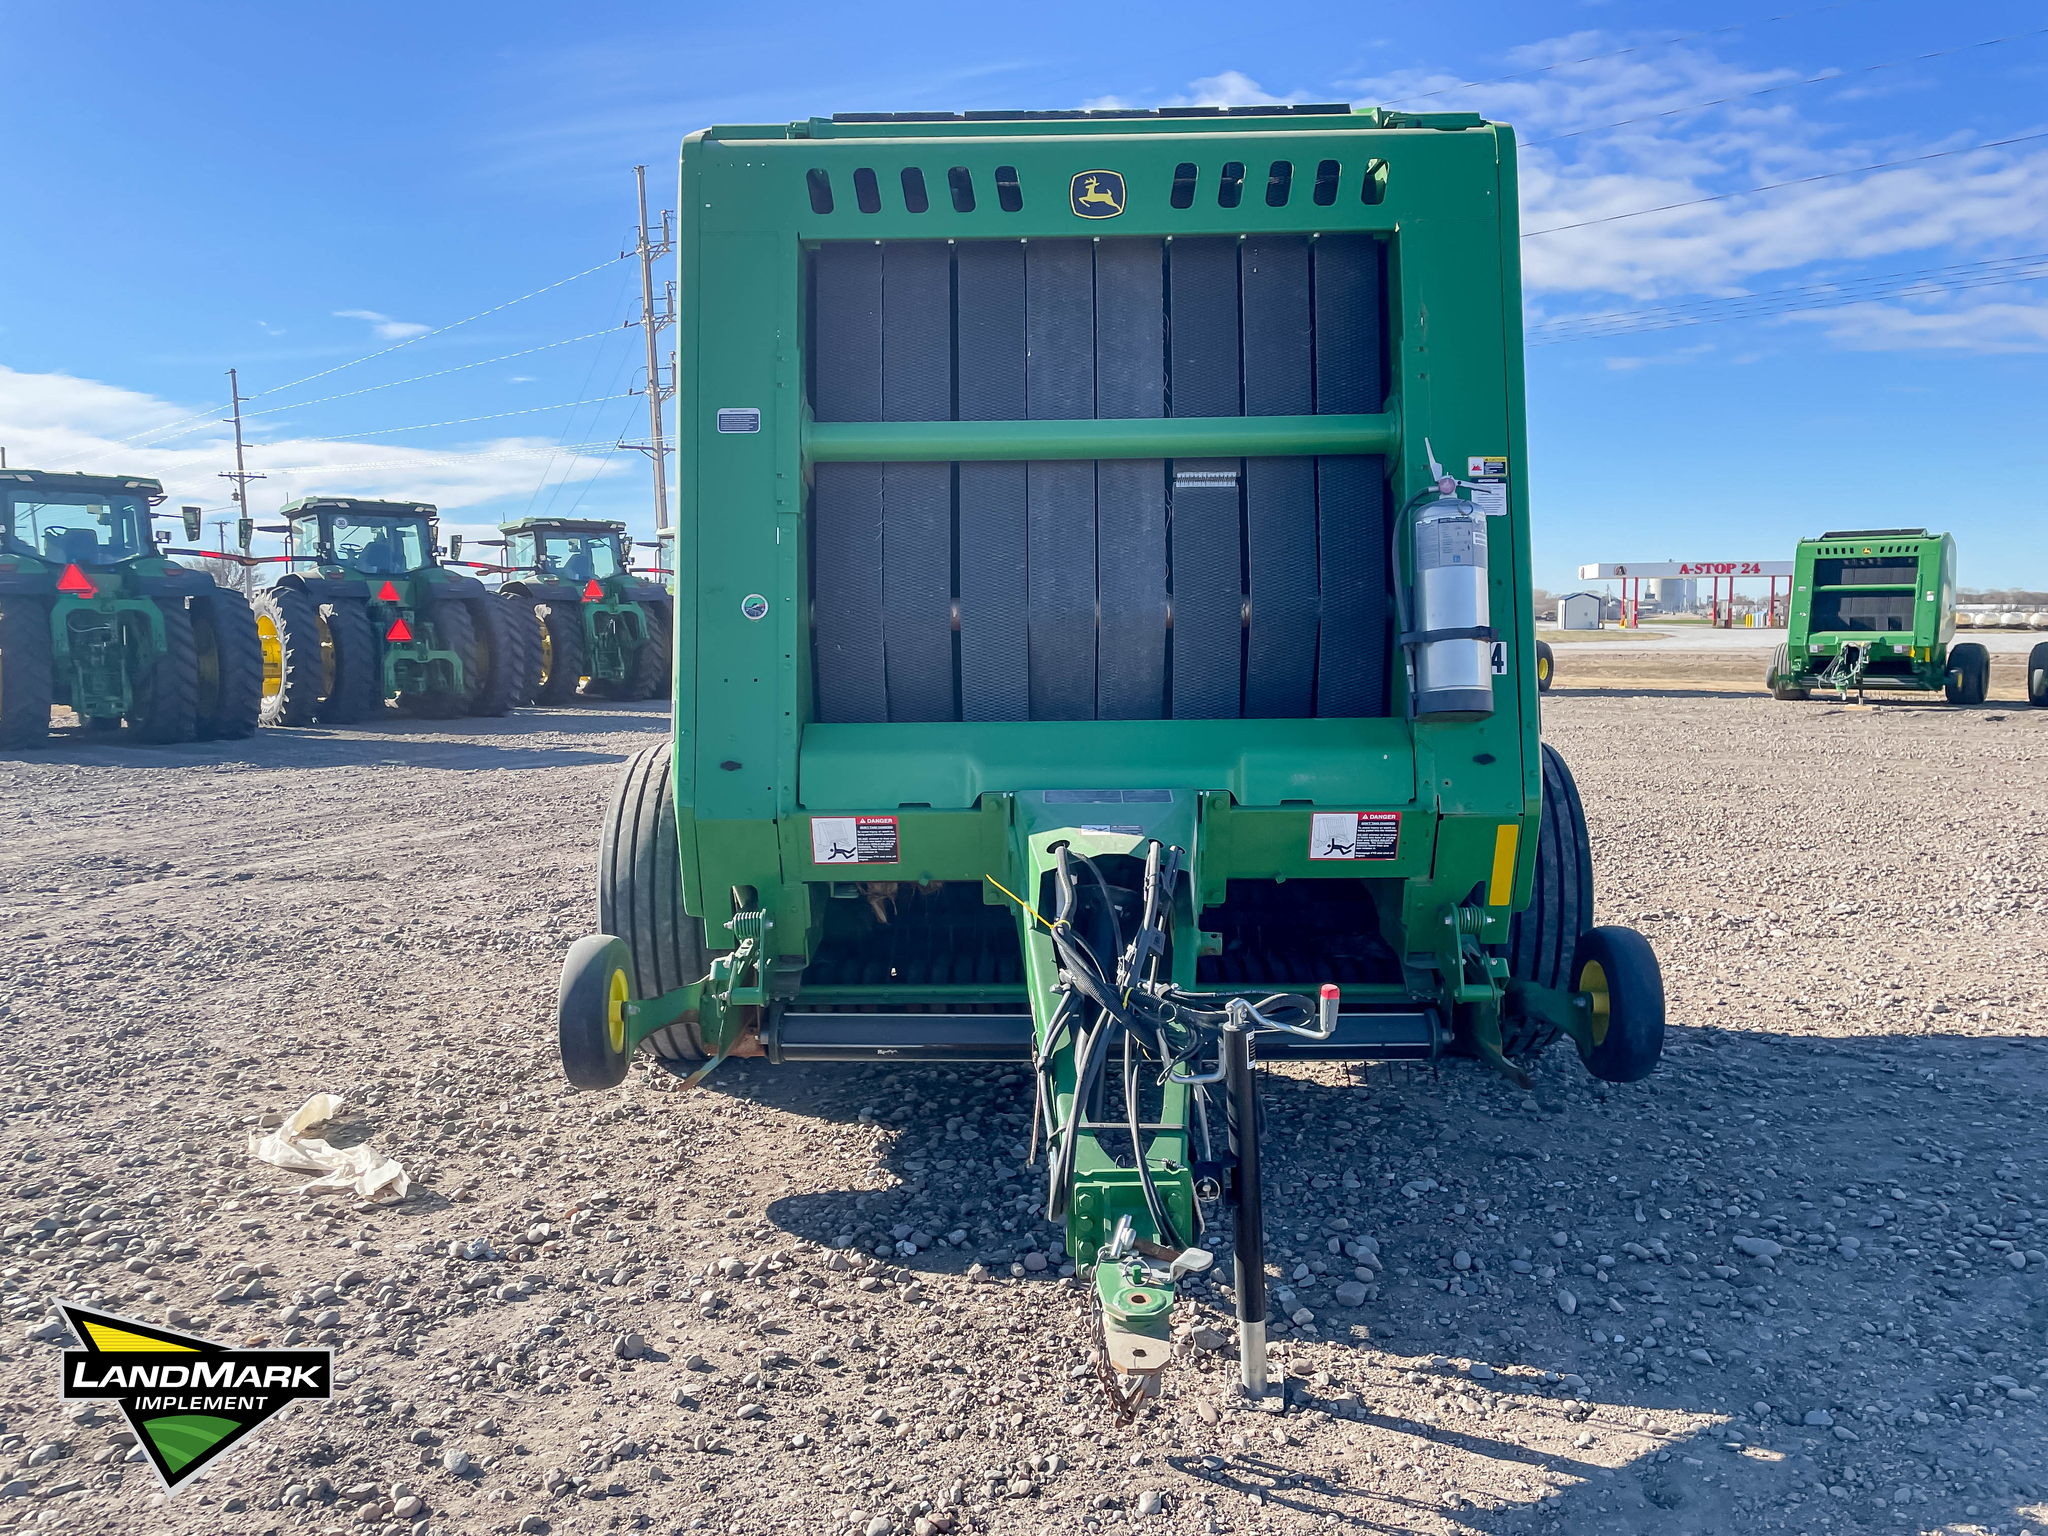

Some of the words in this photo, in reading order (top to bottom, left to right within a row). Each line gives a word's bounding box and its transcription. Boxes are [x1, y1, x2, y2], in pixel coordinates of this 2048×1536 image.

[1678, 563, 1737, 575] A-STOP
[1741, 562, 1761, 575] 24
[1491, 642, 1504, 673] 4
